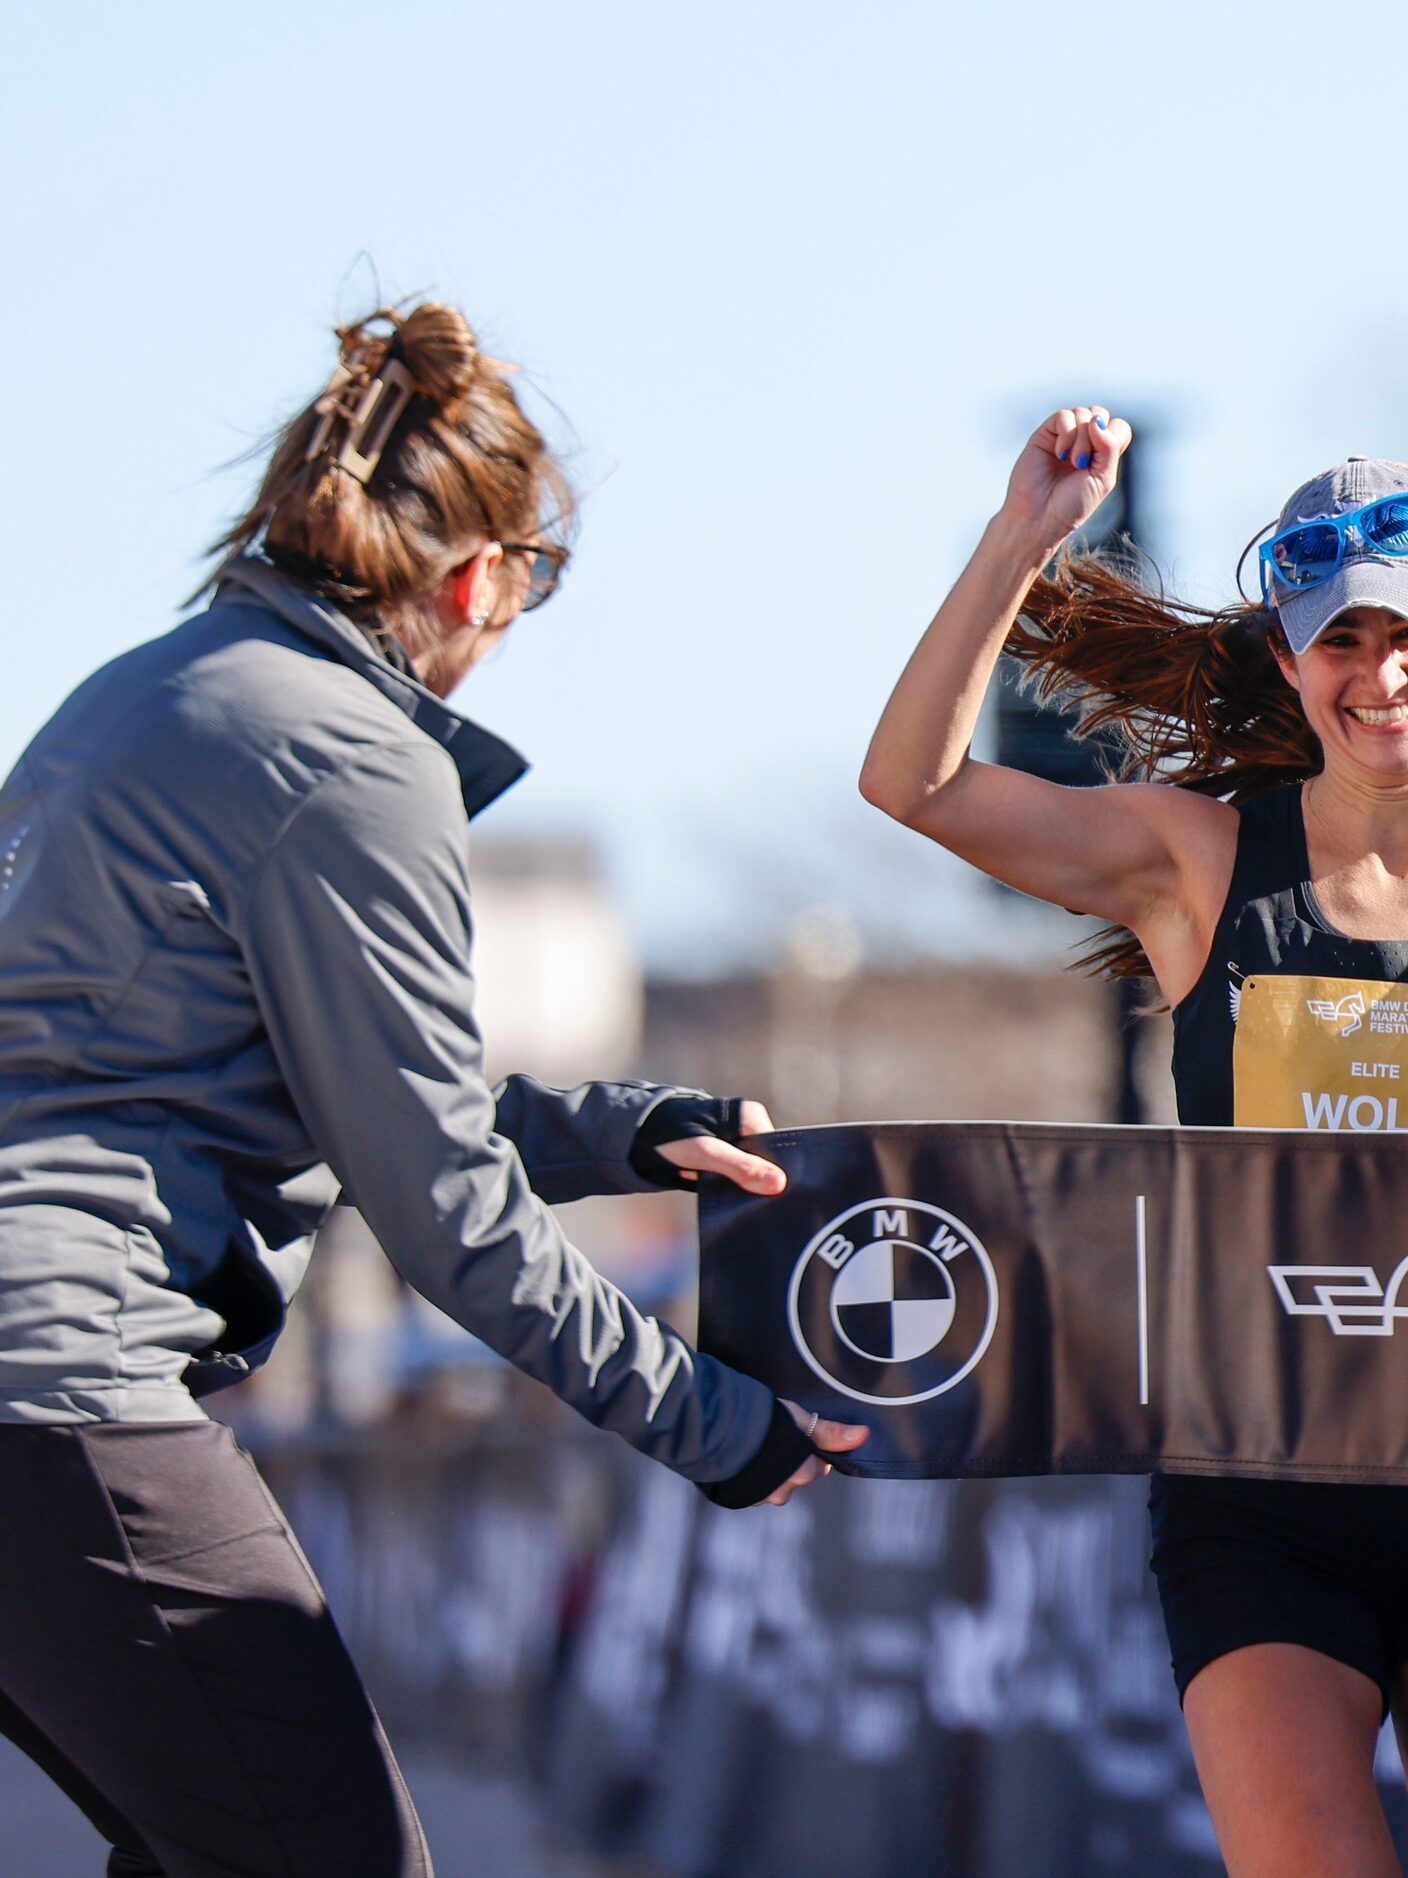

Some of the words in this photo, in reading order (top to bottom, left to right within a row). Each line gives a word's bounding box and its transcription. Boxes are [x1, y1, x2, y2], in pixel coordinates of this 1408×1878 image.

[1370, 999, 1401, 1012] BMW
[1350, 1061, 1401, 1079] ELITE
[817, 1209, 969, 1270] BMW
